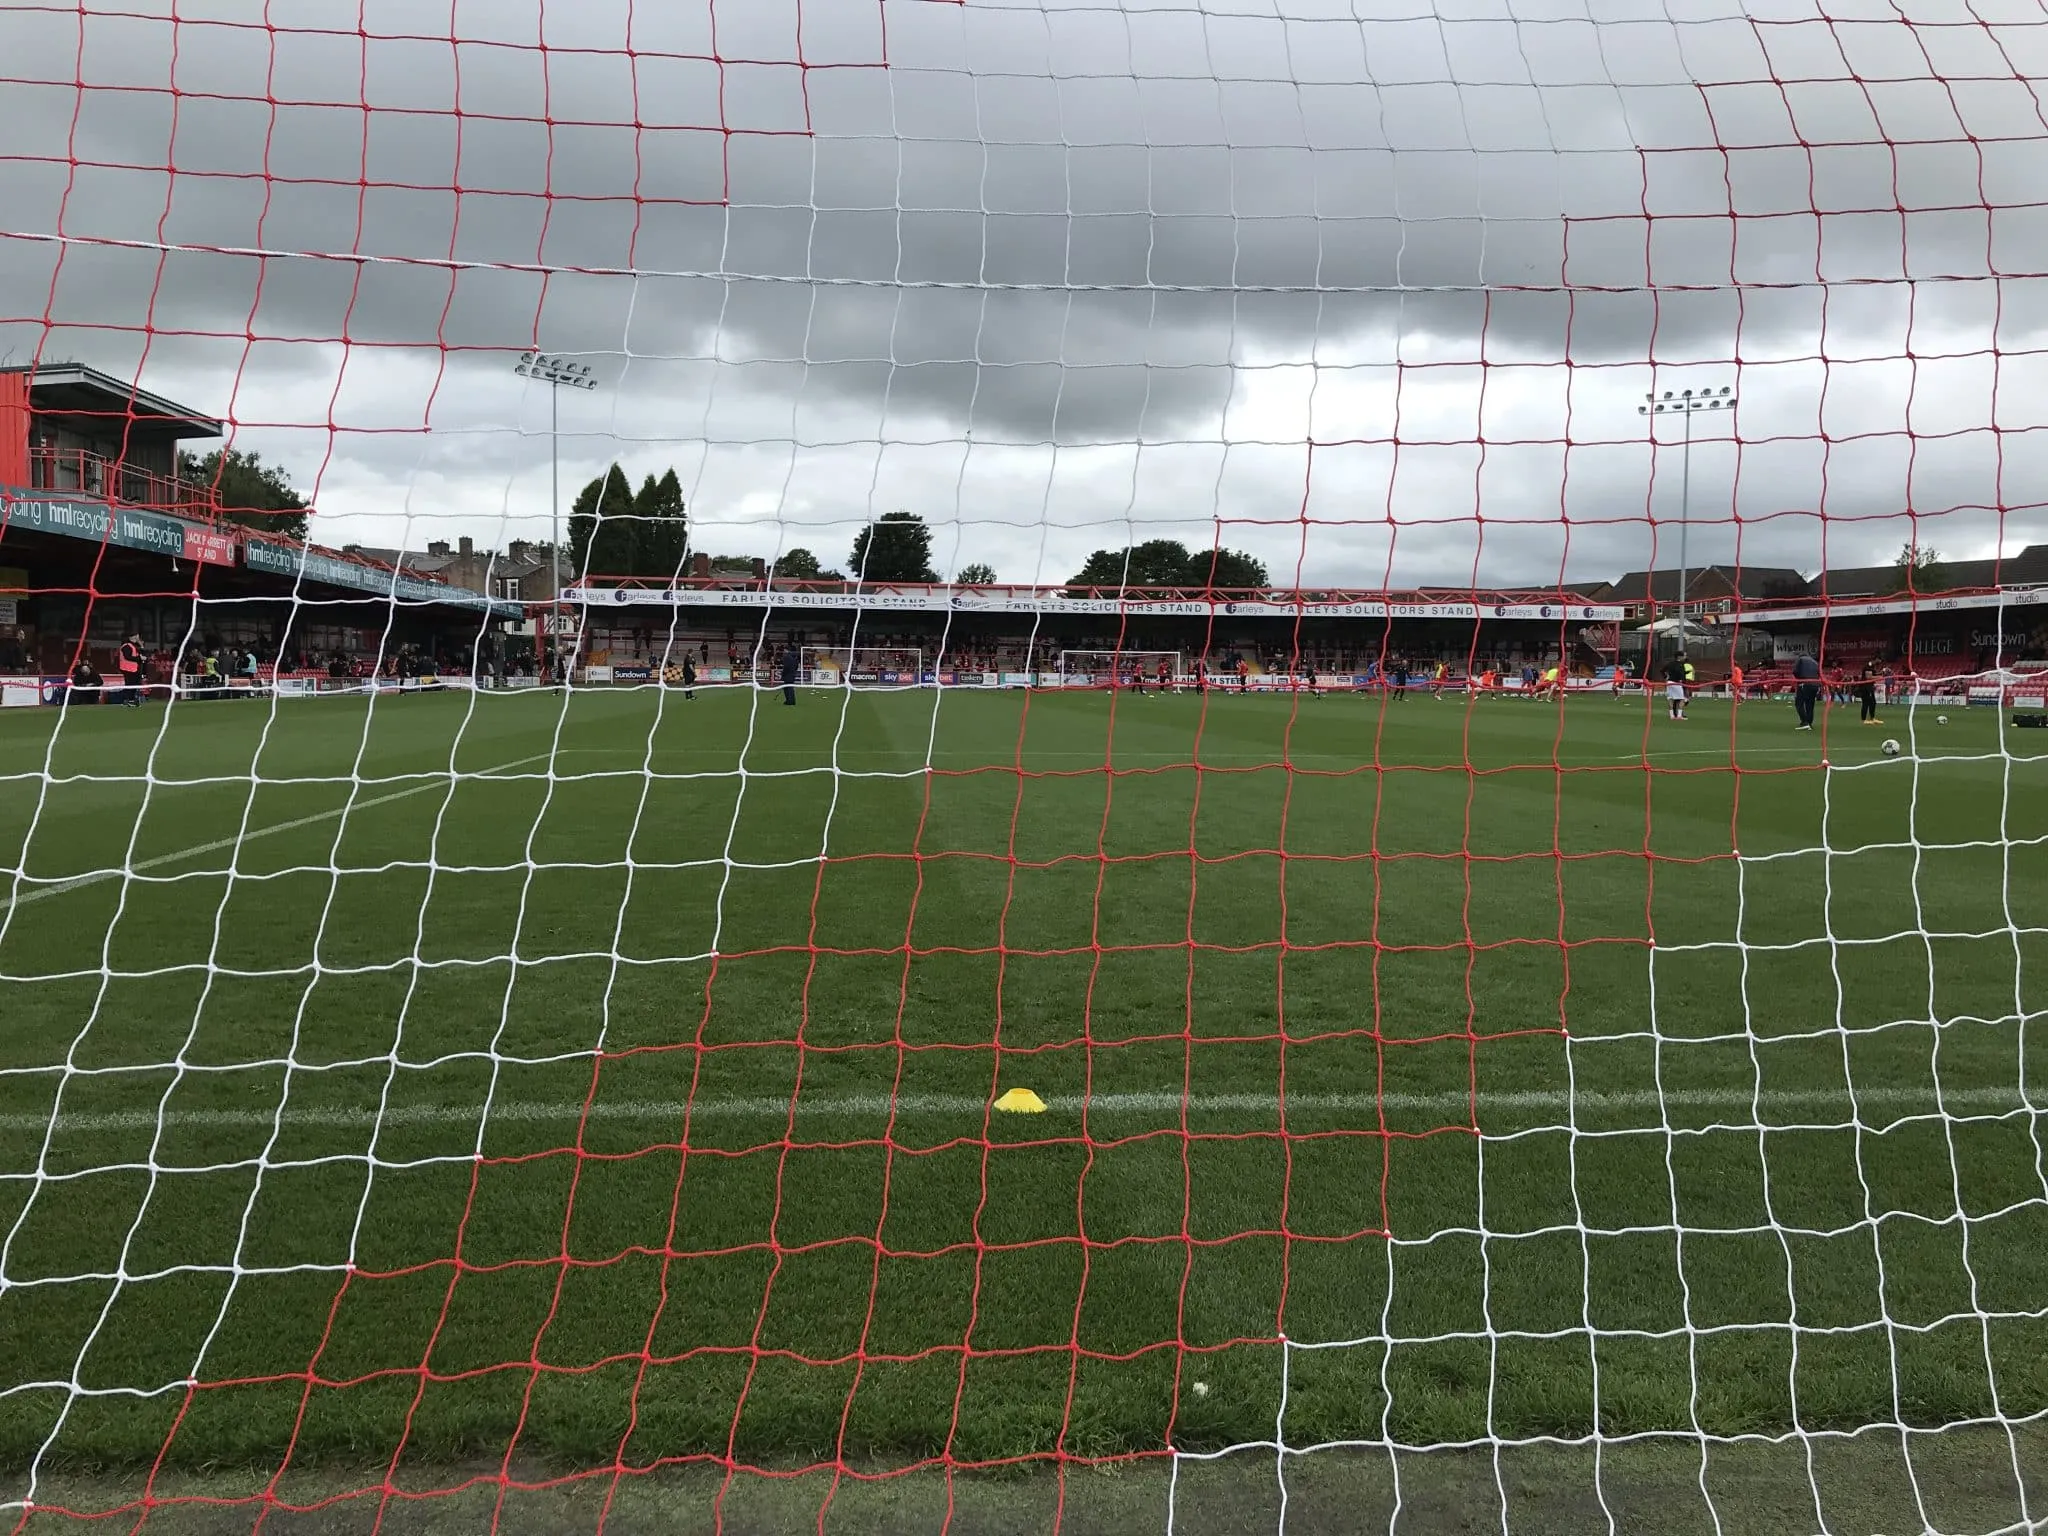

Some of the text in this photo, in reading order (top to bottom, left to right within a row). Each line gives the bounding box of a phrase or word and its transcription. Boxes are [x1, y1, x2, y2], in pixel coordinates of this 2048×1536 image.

[123, 515, 182, 553] hmlrecycling
[197, 547, 217, 560] SAND
[249, 542, 291, 572] hmlrecycling
[564, 589, 606, 602] Faleys
[1072, 602, 1153, 612] SOLICIORS
[1160, 603, 1203, 613] STAND
[1225, 603, 1264, 615] Farleys
[1280, 604, 1473, 616] FALEYS SOLICTORS STAND
[1936, 599, 1958, 609] studio
[1495, 606, 1532, 618] Farleys
[1540, 606, 1578, 618] Farlys
[1583, 607, 1621, 619] Farleys
[614, 671, 647, 679] Sundown
[884, 673, 913, 682] sky bet
[939, 673, 953, 681] bet
[1219, 677, 1241, 685] STEE
